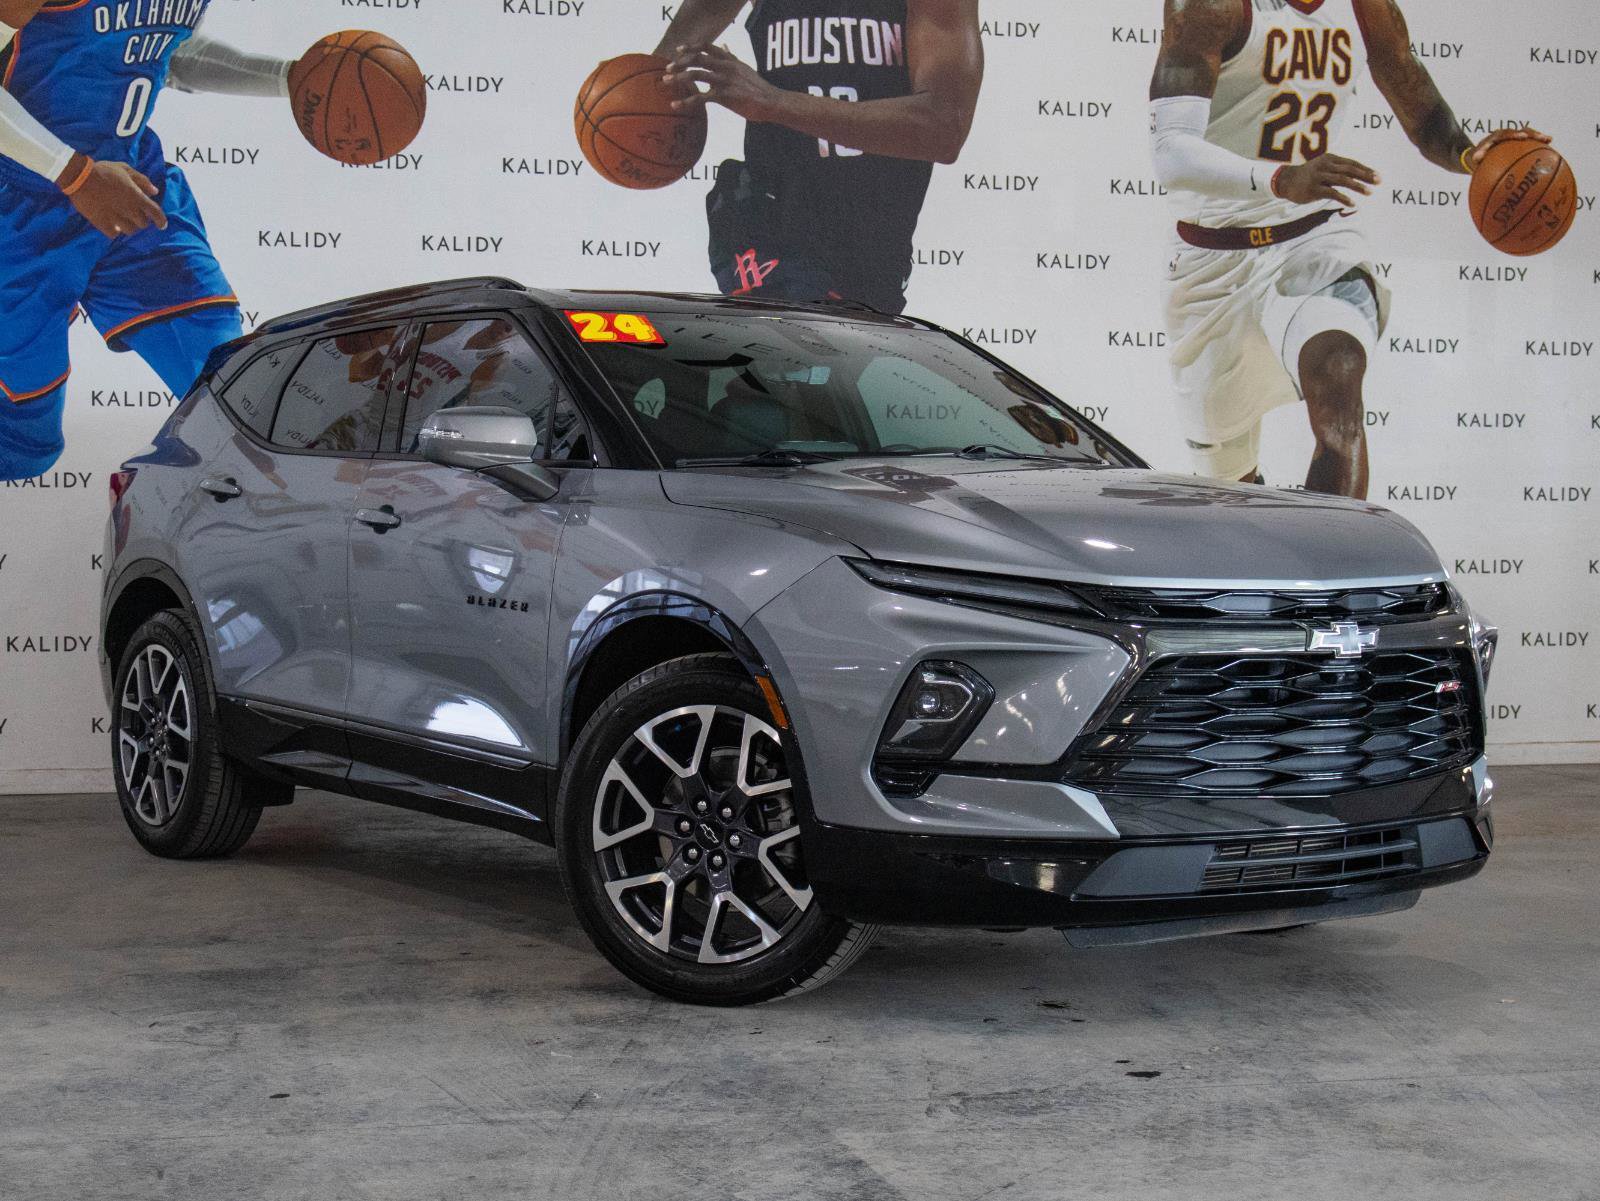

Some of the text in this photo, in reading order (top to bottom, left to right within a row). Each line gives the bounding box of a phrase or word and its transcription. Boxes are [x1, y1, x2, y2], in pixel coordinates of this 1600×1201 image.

[94, 0, 204, 33] OKLAHOM
[502, 0, 585, 17] KALIDY
[981, 22, 1041, 39] ALIDY
[1112, 26, 1166, 44] KALI
[123, 33, 175, 64] CITY
[766, 17, 904, 71] HOUSTON
[1409, 42, 1464, 59] ALIDY
[1262, 28, 1352, 87] CAVS
[1530, 47, 1598, 65] KALIDY
[423, 74, 504, 93] KALIDY
[1038, 100, 1113, 118] KALIDY
[1256, 90, 1337, 163] 23
[1353, 114, 1394, 130] IDY
[175, 146, 260, 165] KALIDY
[502, 157, 584, 176] KALIDY
[964, 173, 1039, 191] KALIDY
[1392, 189, 1462, 206] KALIDY
[258, 230, 342, 248] KALIDY
[422, 235, 503, 253] KALIDY
[1250, 226, 1273, 246] CLE
[581, 239, 661, 257] KALIDY
[912, 250, 965, 266] LIDY
[1036, 253, 1111, 270] KALIDY
[1459, 265, 1528, 282] KALIDY
[570, 312, 657, 342] 24
[962, 327, 1037, 345] KALIDY
[1108, 331, 1167, 347] KALID
[1389, 337, 1459, 354] KALIDY
[1525, 340, 1594, 357] KALIDY
[91, 390, 175, 408] KALIDY
[886, 403, 961, 421] KALIDY
[1457, 412, 1526, 429] KALIDY
[6, 472, 93, 489] KALIDY
[1387, 485, 1458, 501] KALIDY
[1523, 487, 1592, 502] KALIDY
[1455, 559, 1524, 575] KALIDY
[466, 594, 529, 613] BLAZER
[6, 635, 93, 653] KALIDY
[1521, 631, 1589, 648] KALIDY
[1490, 704, 1522, 720] IDY
